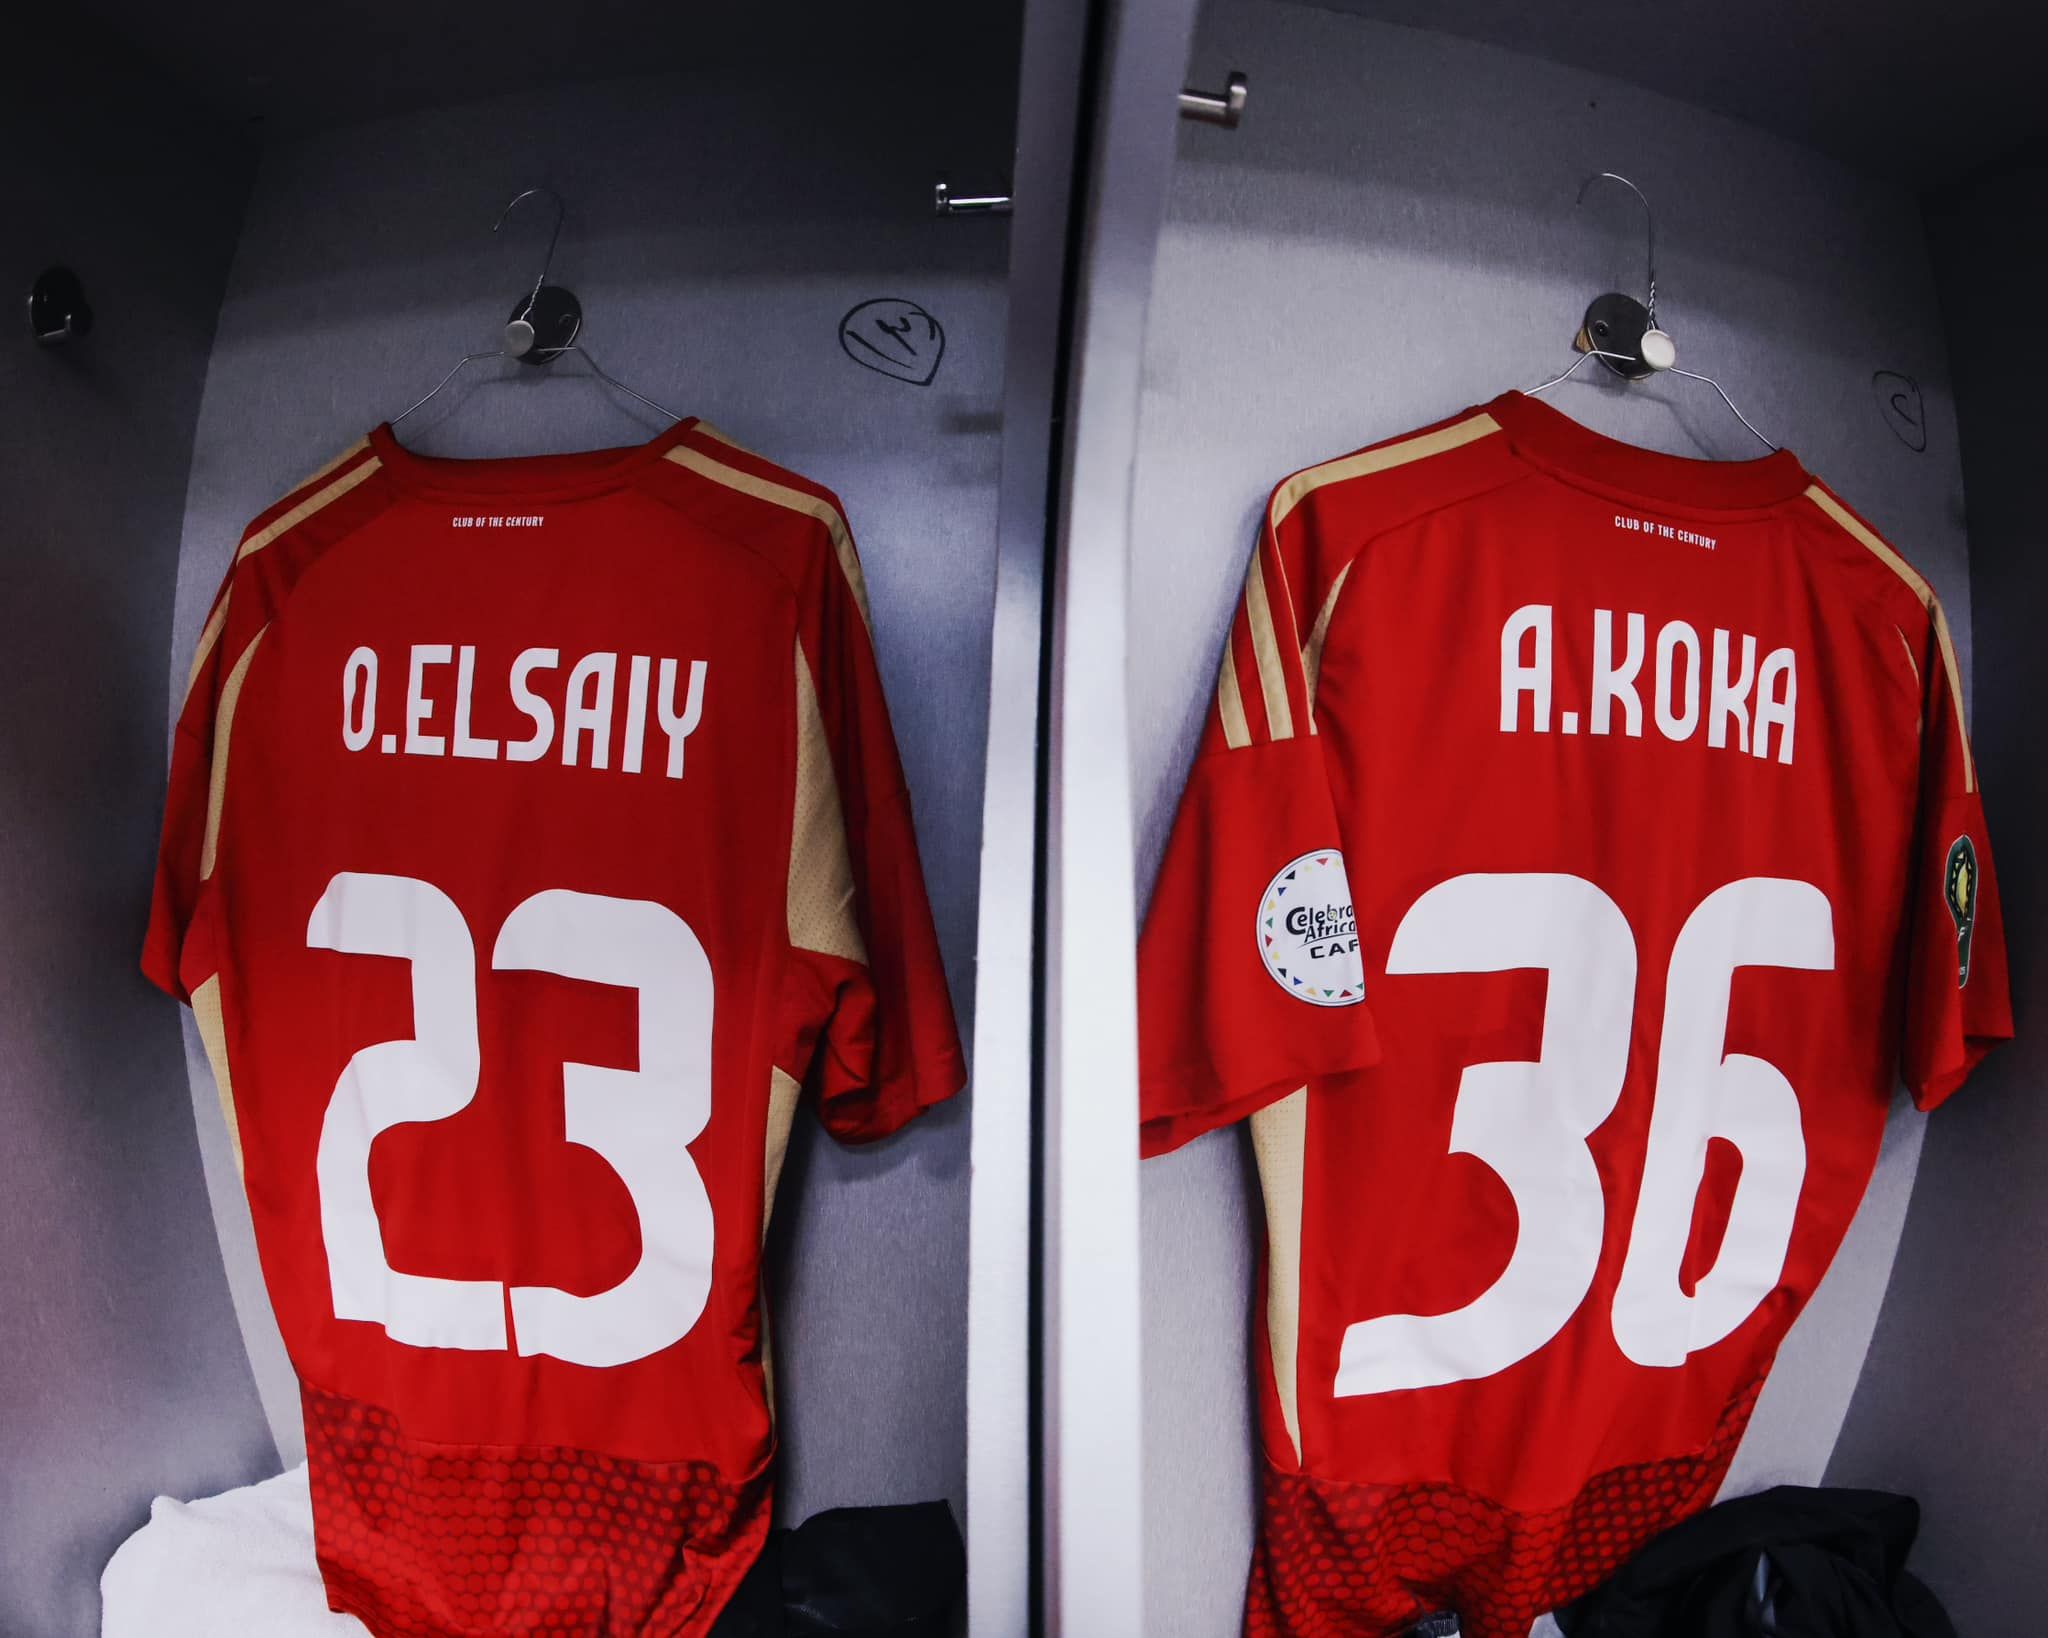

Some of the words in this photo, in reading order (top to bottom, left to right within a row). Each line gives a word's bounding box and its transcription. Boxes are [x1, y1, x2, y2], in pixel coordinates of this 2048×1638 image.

[452, 517, 473, 528] CLUB
[475, 517, 486, 528] OF
[488, 517, 503, 527] THE
[505, 516, 544, 527] CENTURY
[1615, 516, 1640, 531] CLUB
[1643, 521, 1655, 534] OF
[1658, 524, 1675, 539] THE
[1677, 529, 1717, 550] CENTURY
[342, 644, 708, 779] O.ELSAIY
[1500, 604, 1797, 765] A.KOKA
[306, 872, 715, 1368] 23
[1334, 872, 1836, 1399] 36
